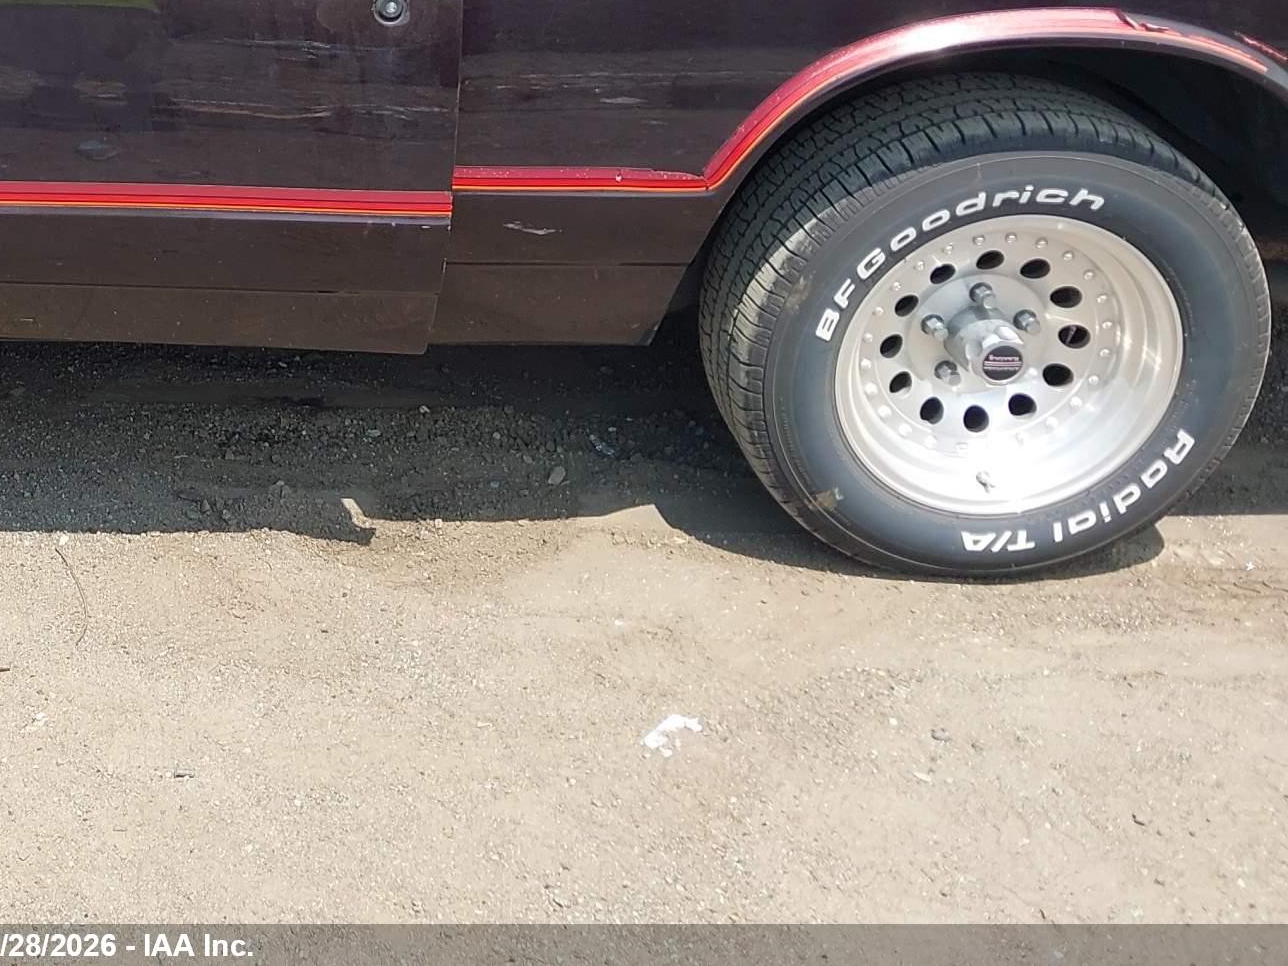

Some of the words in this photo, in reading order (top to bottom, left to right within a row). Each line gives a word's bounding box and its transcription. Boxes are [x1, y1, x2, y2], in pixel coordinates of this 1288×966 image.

[815, 184, 1106, 342] BFGoodrich
[960, 529, 1036, 553] T/A
[1052, 428, 1196, 543] Radial
